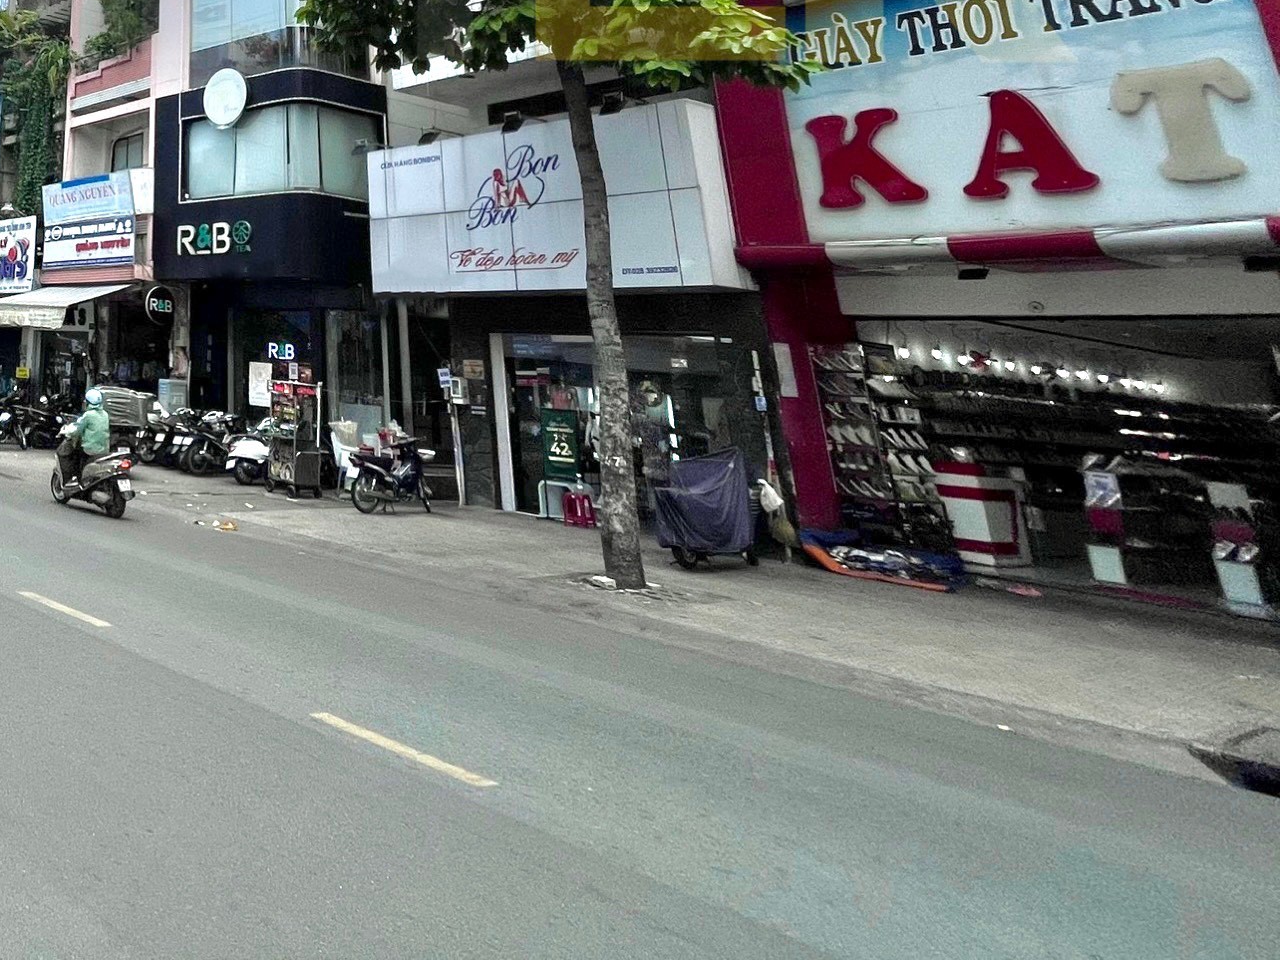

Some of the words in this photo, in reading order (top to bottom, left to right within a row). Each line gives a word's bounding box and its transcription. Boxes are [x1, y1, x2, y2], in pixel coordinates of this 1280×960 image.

[805, 56, 1252, 209] KAT
[505, 144, 560, 183] Bon
[465, 196, 519, 231] Bon
[176, 221, 231, 255] R&B
[149, 297, 173, 313] R&B
[268, 342, 295, 360] R&B
